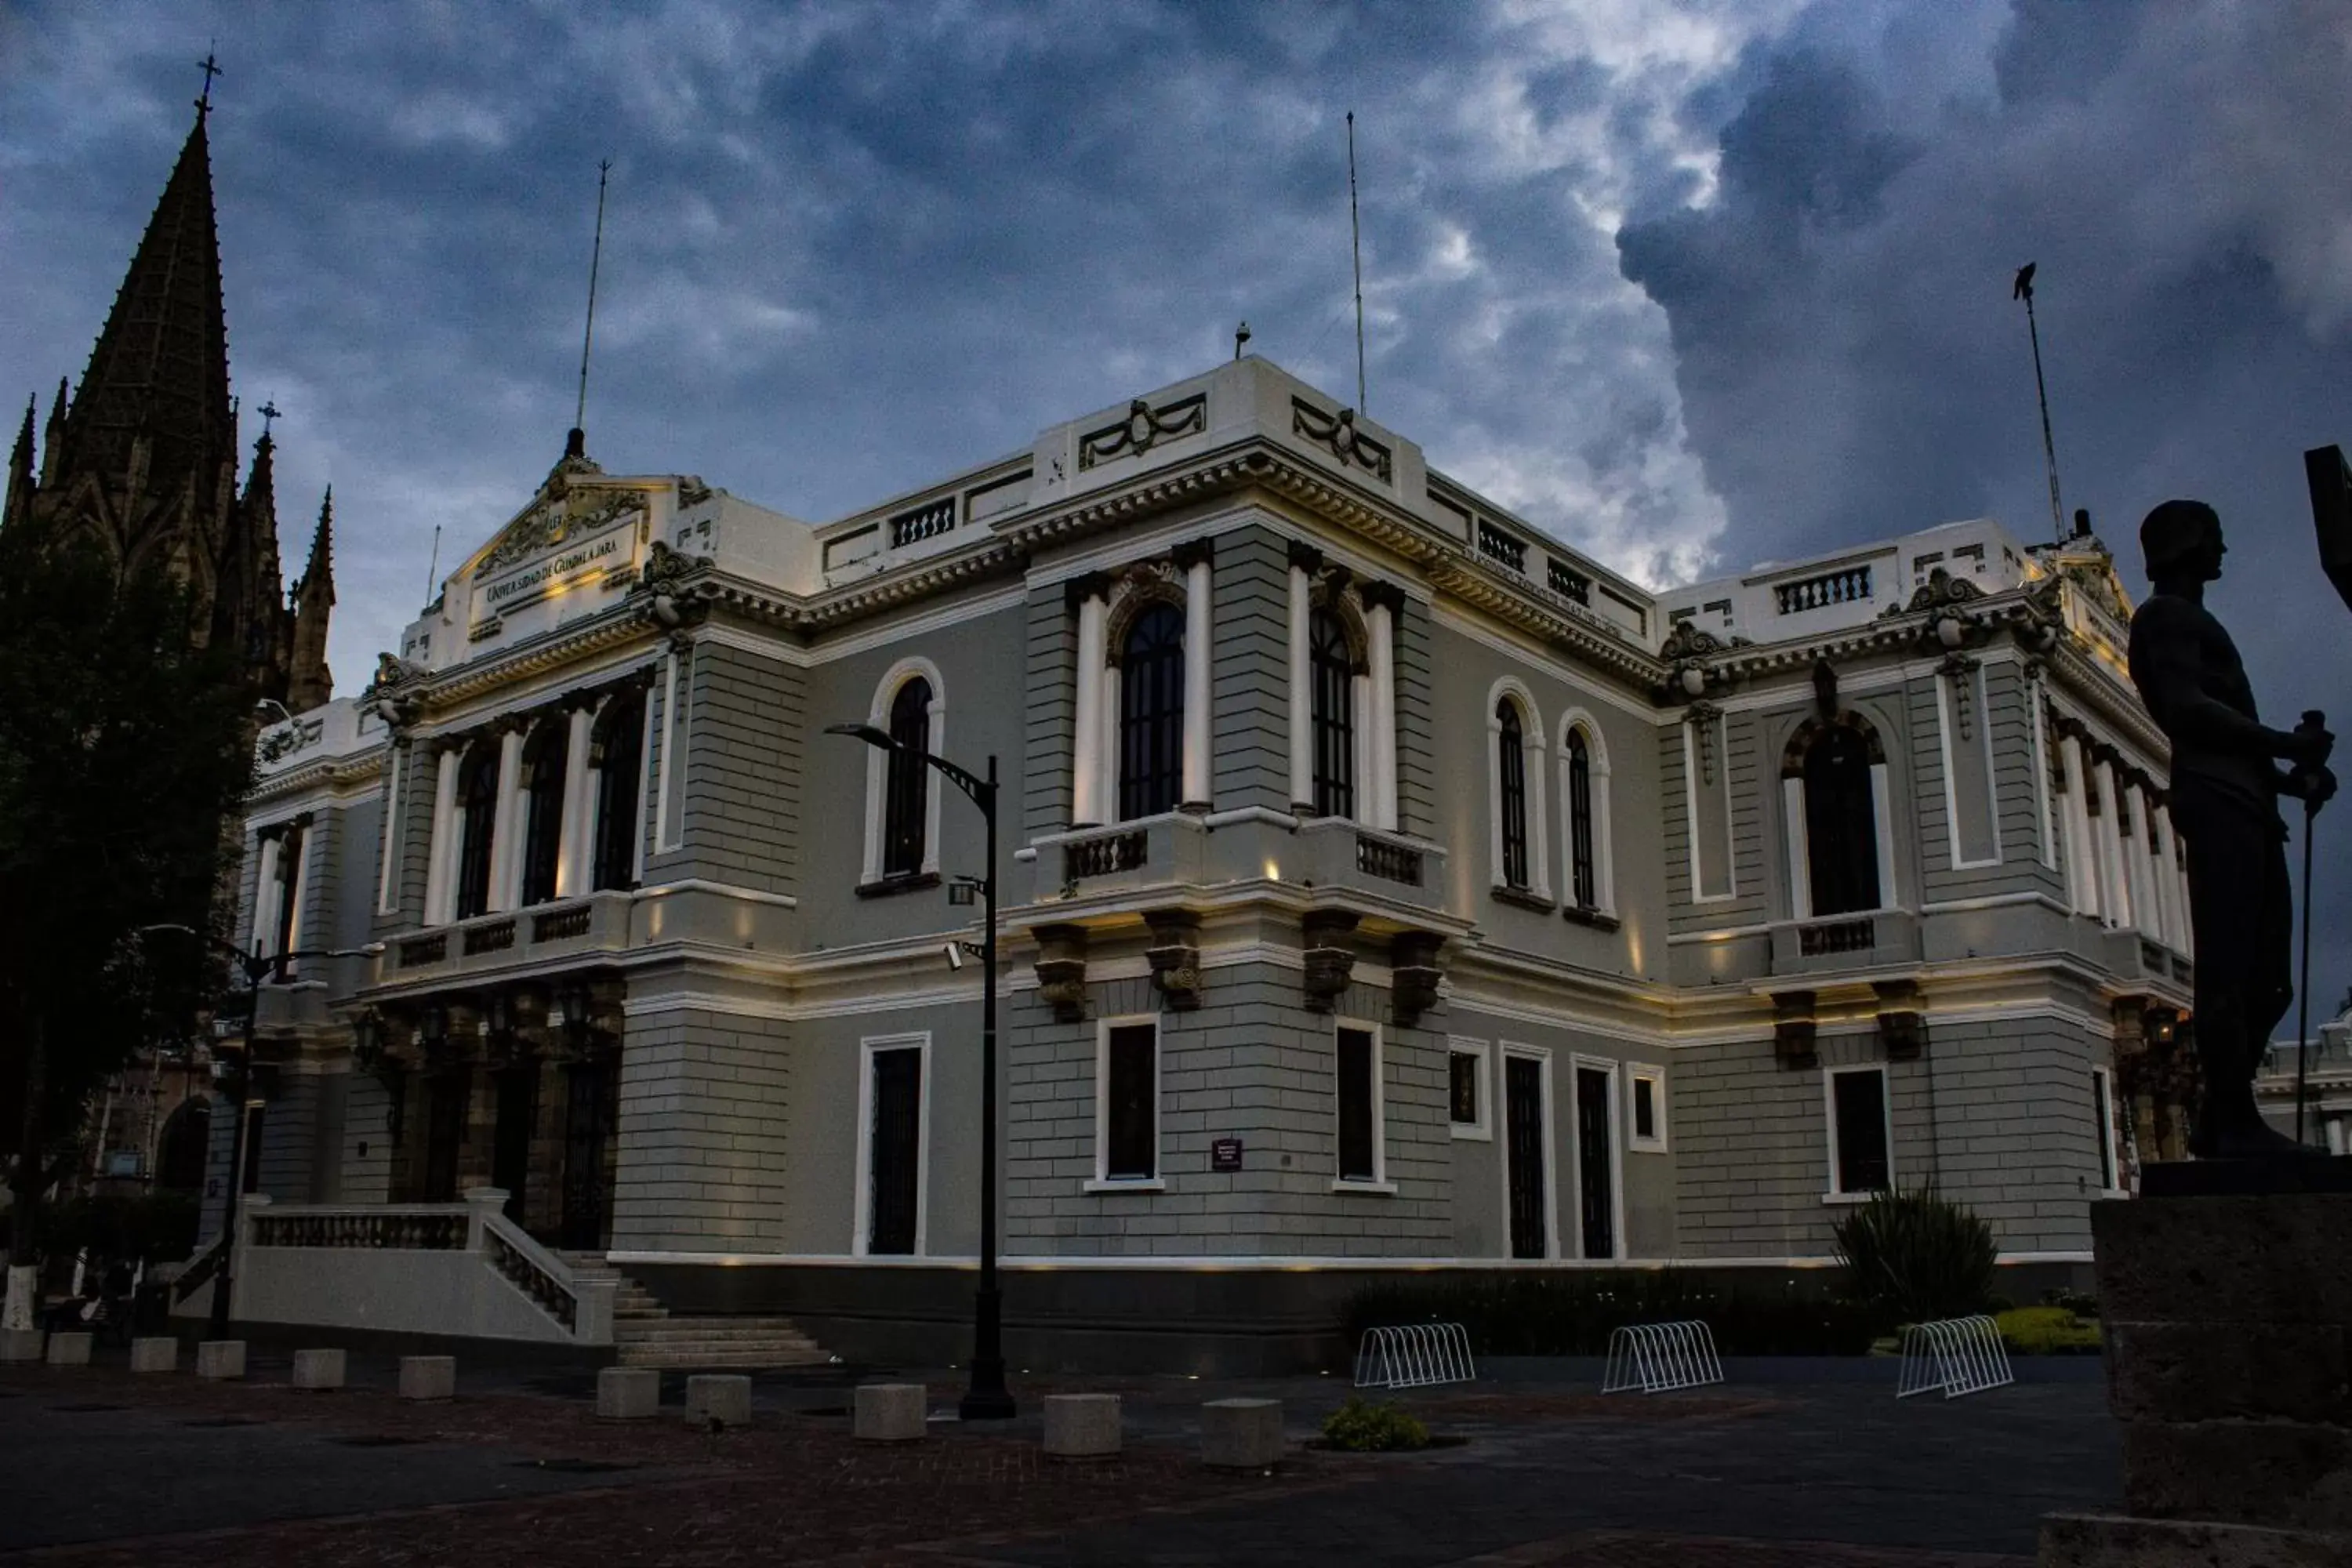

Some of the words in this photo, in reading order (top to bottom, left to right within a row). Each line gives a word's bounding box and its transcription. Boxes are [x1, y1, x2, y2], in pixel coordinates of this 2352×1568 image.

[487, 570, 541, 602] UNIVERSIDAD
[542, 564, 552, 580] DE
[554, 539, 616, 574] GUADALAJARA
